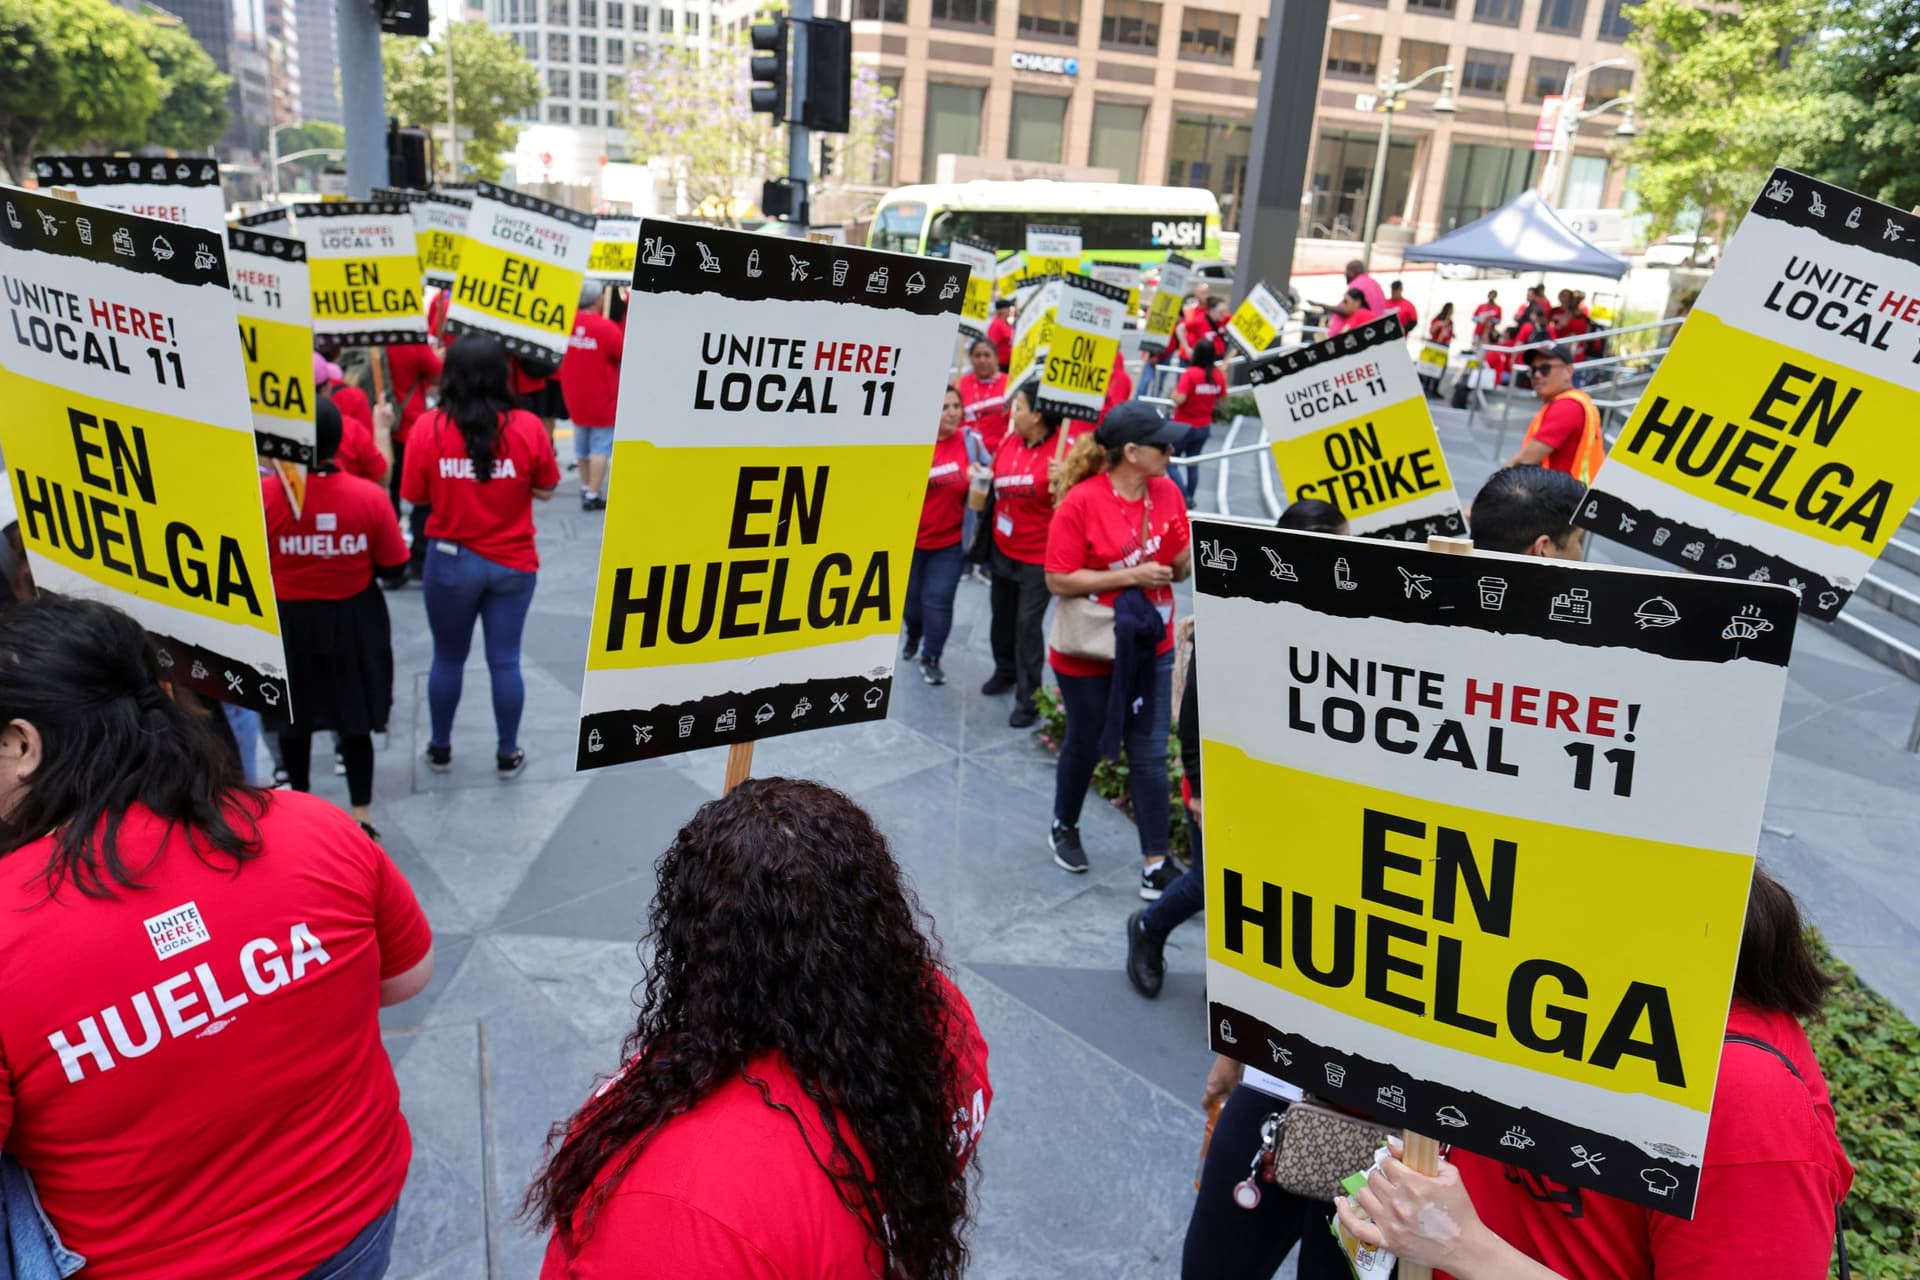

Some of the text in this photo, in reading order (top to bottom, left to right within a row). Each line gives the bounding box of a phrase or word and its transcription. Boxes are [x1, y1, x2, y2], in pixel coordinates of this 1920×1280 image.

[321, 237, 395, 248] LOCAL 11
[432, 232, 455, 251] EN
[492, 225, 568, 257] LOCAL 11
[603, 243, 624, 256] ON
[1152, 221, 1202, 246] DASH
[344, 263, 380, 286] EN
[500, 258, 541, 290] EN
[1785, 256, 1879, 306] UNITE
[3, 275, 178, 346] UNITE HERE!
[264, 290, 281, 309] 11
[313, 290, 418, 314] HUELGA
[458, 275, 566, 331] HUELGA
[1764, 281, 1893, 351] LOCAL
[11, 309, 186, 389] LOCAL 11
[239, 323, 258, 363] N
[701, 332, 903, 377] UNITE HERE!
[1071, 336, 1097, 364] ON
[692, 371, 895, 416] LOCAL 11
[1047, 358, 1107, 393] STRIKE
[1286, 363, 1381, 405] UNITE HERE!
[1289, 378, 1387, 422] LOCAL 11
[1749, 362, 1862, 448] EN
[67, 407, 157, 504] EN
[439, 458, 517, 479] HUEGA
[1324, 422, 1383, 472] ON
[1627, 397, 1894, 544] HUELGA
[728, 465, 830, 549] EN
[16, 468, 264, 617] HUELGA
[279, 533, 368, 555] HUELGA
[605, 550, 892, 652] HUELGA
[1288, 645, 1642, 742] UNITE HERE!
[1288, 687, 1636, 798] LOCAL 11
[1360, 808, 1518, 938] EN
[149, 907, 197, 934] UNITE
[153, 919, 201, 946] HERE!
[158, 929, 207, 954] LOCAL 11
[1223, 868, 1688, 1089] HUELGA
[47, 922, 332, 1084] HUELGA
